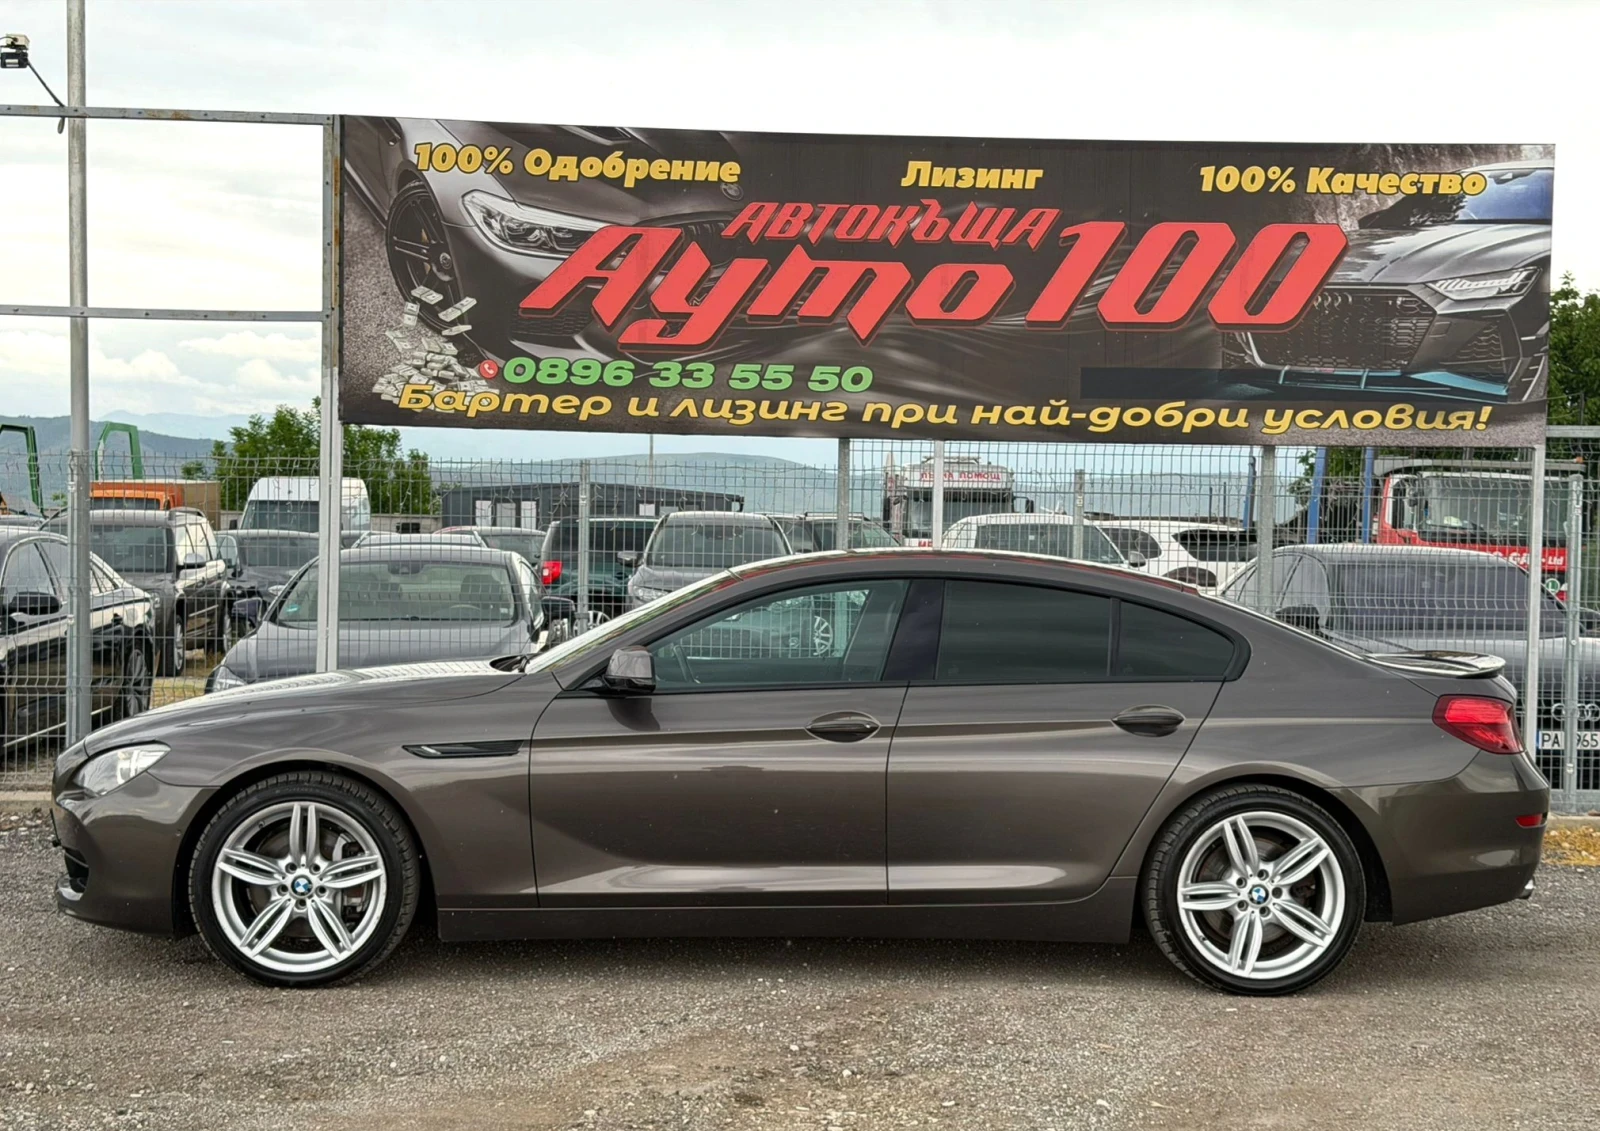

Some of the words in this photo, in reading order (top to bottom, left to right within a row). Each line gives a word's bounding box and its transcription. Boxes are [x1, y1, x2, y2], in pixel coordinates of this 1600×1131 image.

[415, 142, 514, 175] 100%
[523, 147, 741, 189] Одобрение
[900, 159, 1044, 191] Лизинг
[1200, 165, 1296, 194] 100%
[1306, 166, 1487, 196] Качество
[722, 199, 1060, 249] АВТОКЪЩА
[1026, 221, 1349, 326] 100
[504, 357, 636, 388] 0896
[650, 362, 716, 390] 33
[730, 364, 794, 392] 55
[808, 365, 874, 393] 50
[398, 383, 613, 421] Бартер
[627, 397, 660, 417] и
[672, 397, 849, 425] лизинг
[863, 402, 958, 429] при
[971, 400, 1250, 433] най-добри
[1263, 404, 1493, 435] условия!
[1541, 732, 1561, 748] PA
